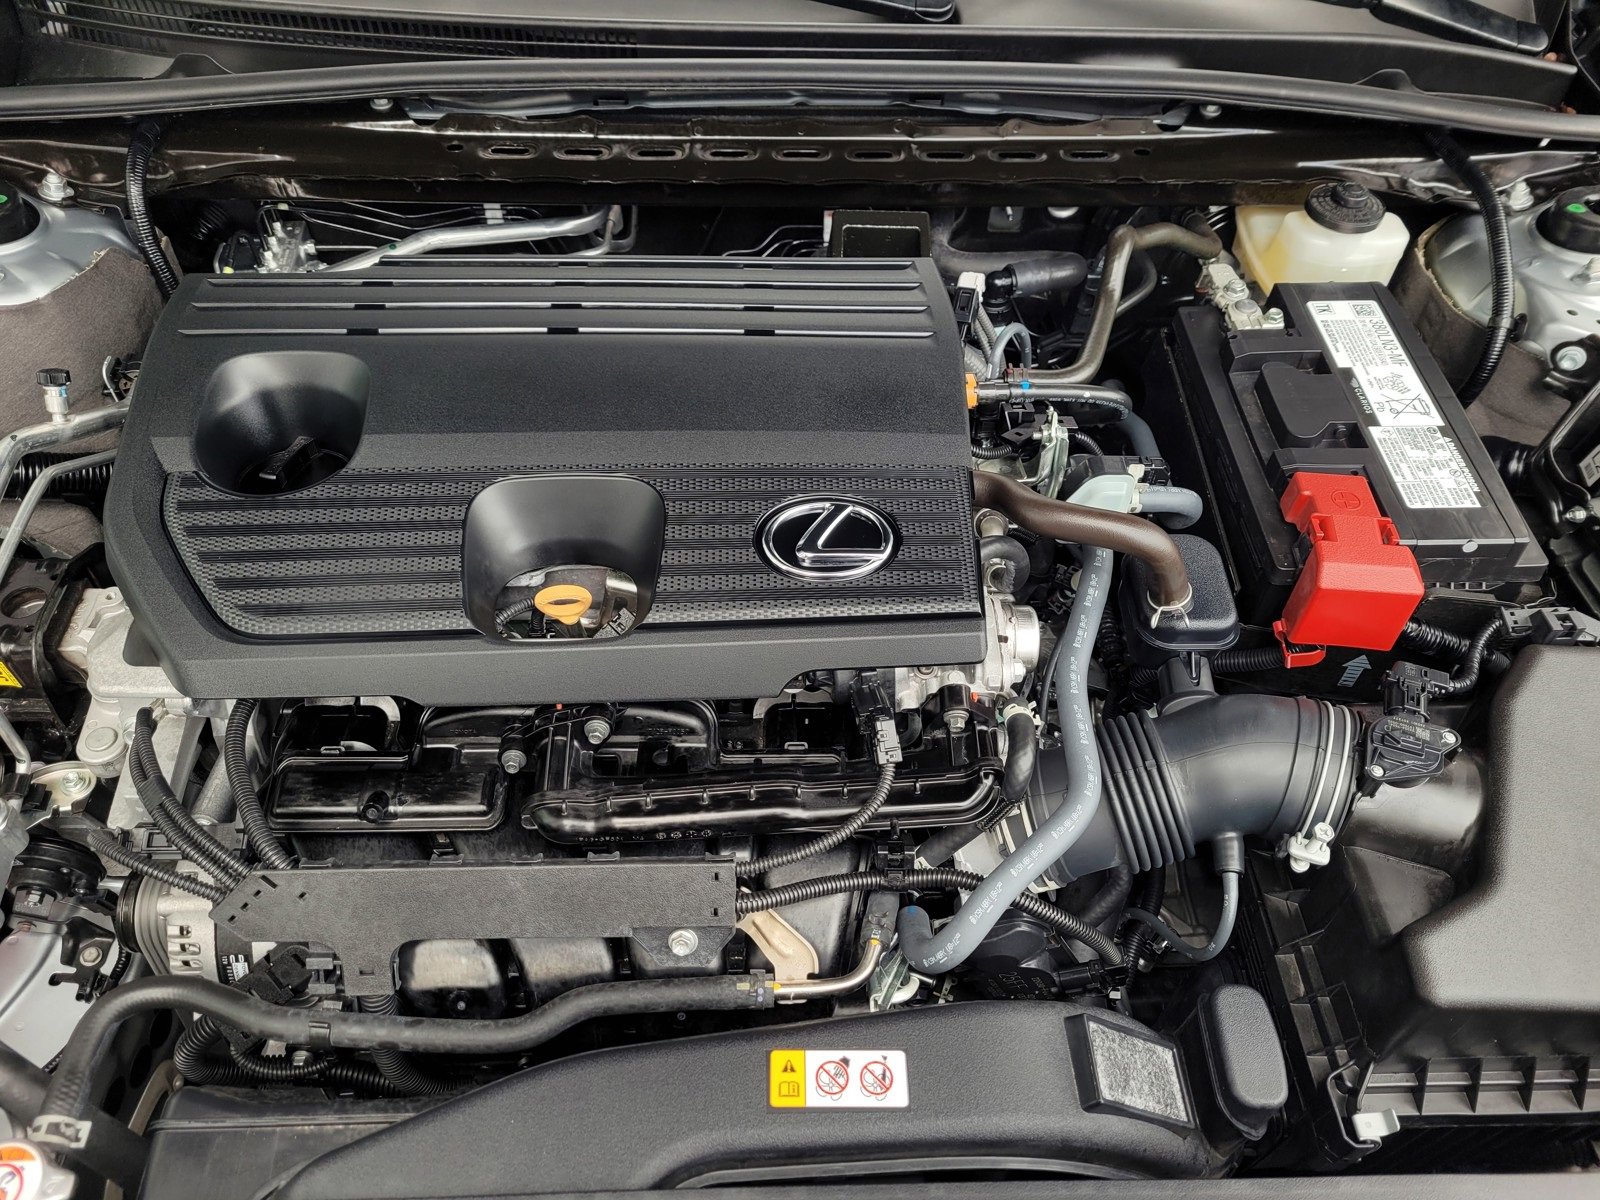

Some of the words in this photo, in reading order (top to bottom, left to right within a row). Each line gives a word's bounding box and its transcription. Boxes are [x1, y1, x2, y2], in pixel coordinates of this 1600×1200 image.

[1315, 303, 1333, 314] TK
[1369, 319, 1409, 367] 380LN3-MF
[1353, 387, 1373, 415] CLARIOS
[1446, 441, 1481, 493] DANGER/POISON
